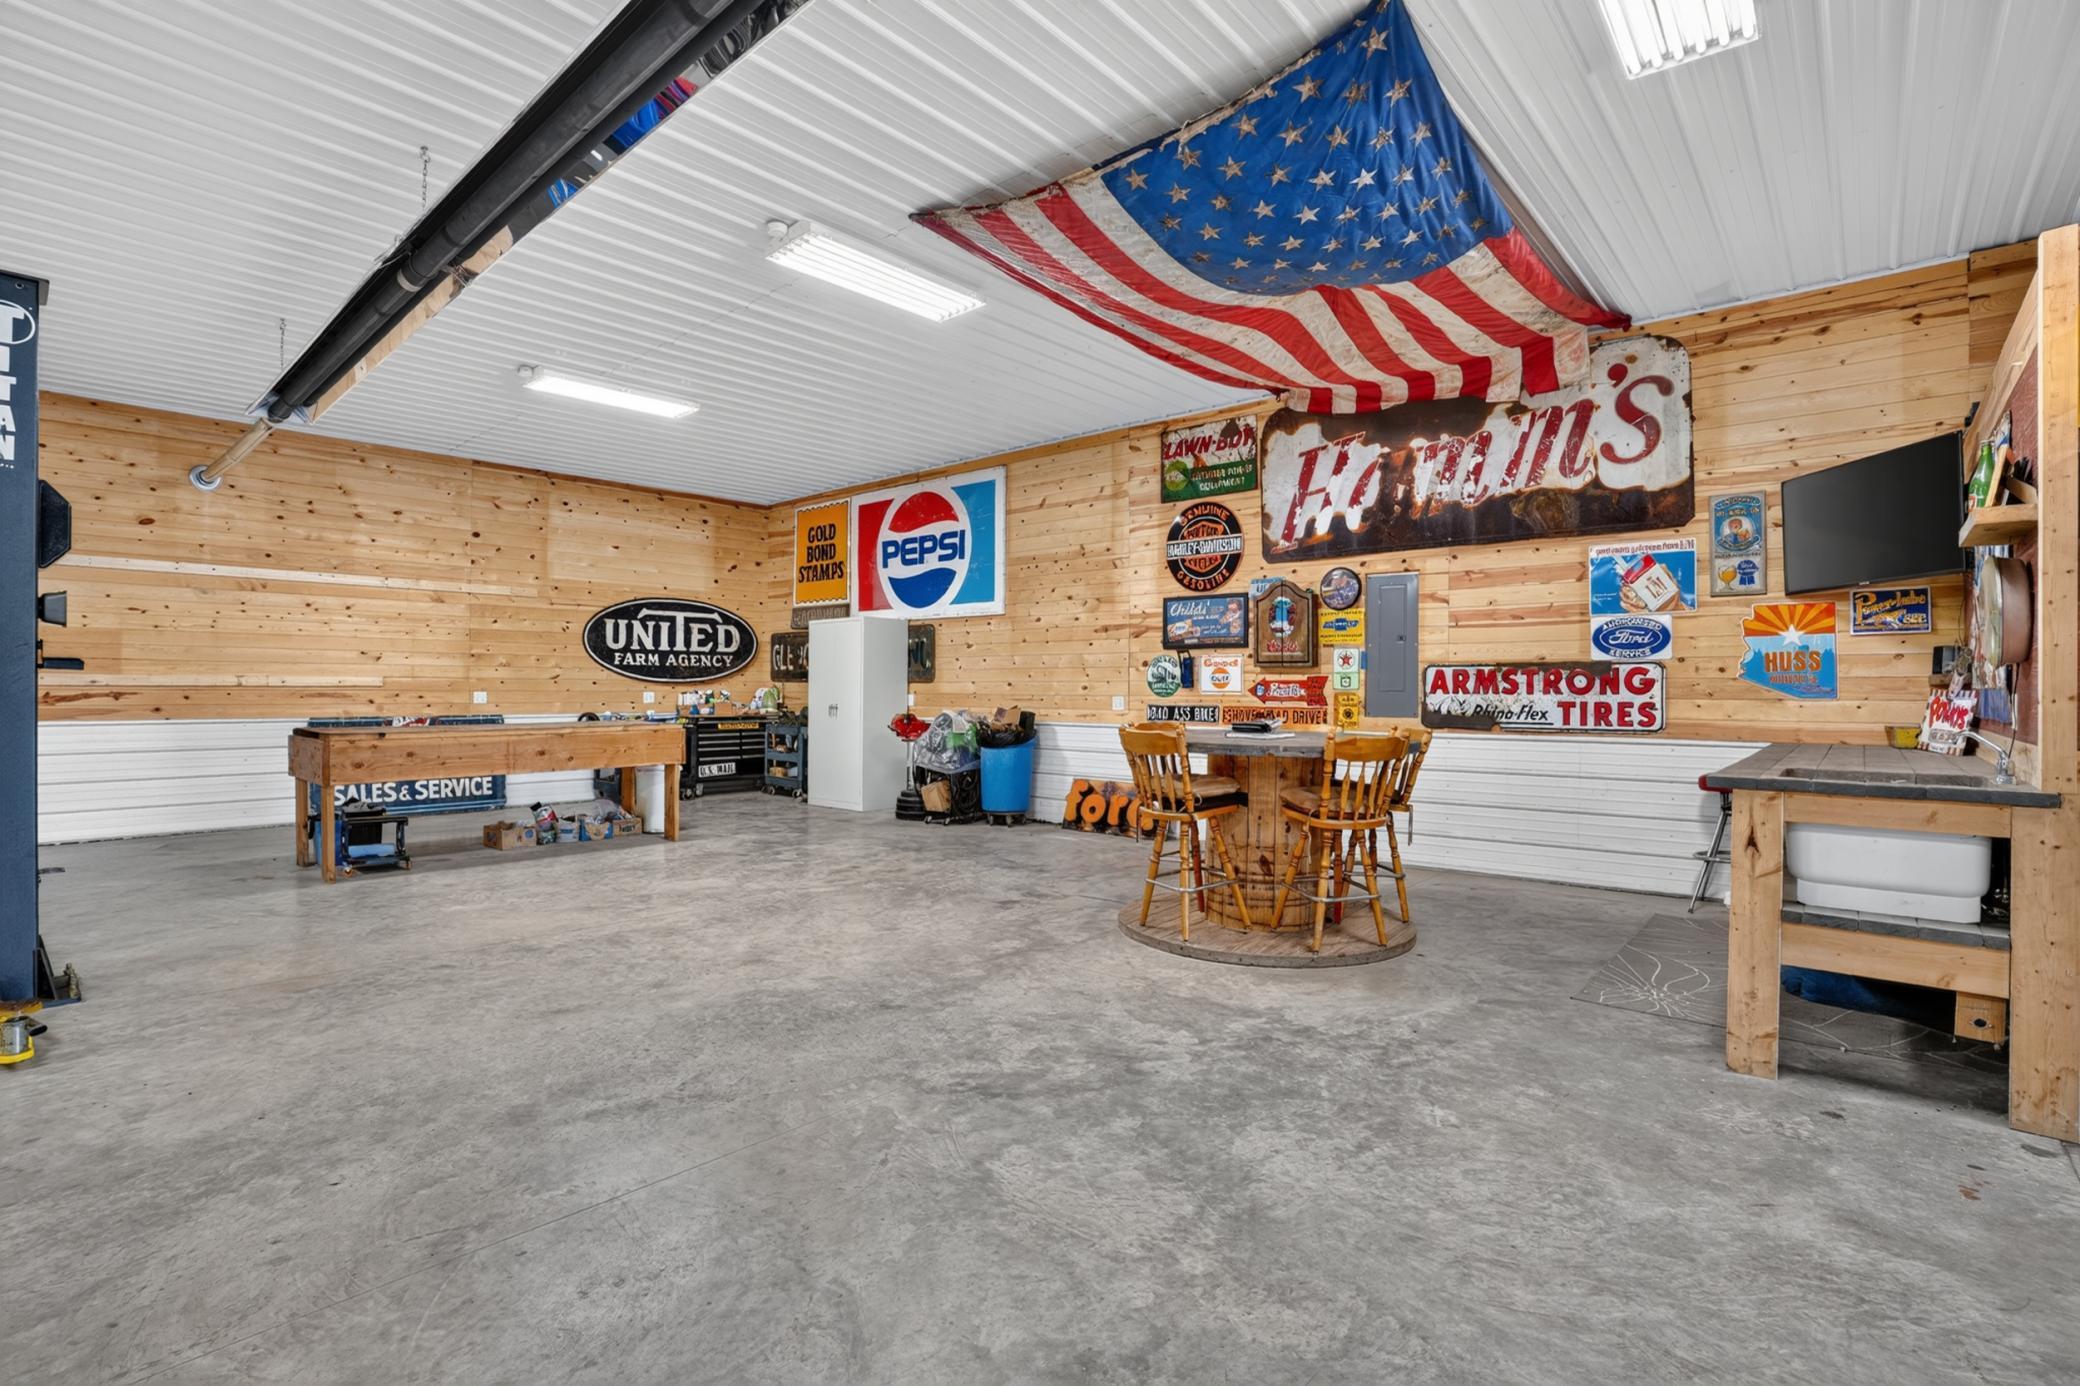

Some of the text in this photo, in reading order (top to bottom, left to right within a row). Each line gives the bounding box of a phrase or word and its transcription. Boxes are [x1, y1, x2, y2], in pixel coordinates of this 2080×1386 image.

[1163, 424, 1255, 460] LAWN-BOY
[1180, 505, 1230, 526] GENUINE
[808, 523, 836, 543] GOLD
[807, 543, 836, 563] BOND
[882, 529, 965, 569] PEPSI
[1167, 537, 1241, 557] HARLEY-DAVIDSON
[799, 560, 844, 583] STAMPS
[1177, 568, 1229, 590] GASOLINE
[604, 608, 740, 653] UNITED
[1609, 628, 1654, 645] Ford
[613, 652, 734, 667] FARM AGENCY
[1608, 648, 1652, 659] SERVICE
[1765, 650, 1821, 673] HUSS
[1429, 667, 1656, 696] ARMSTRONG
[1151, 706, 1214, 721] BAD ASS BIKE
[1292, 709, 1320, 724] DRIVE
[1472, 702, 1657, 727] Rhino-Flex TIRES
[334, 775, 493, 803] SALES & SERVICE
